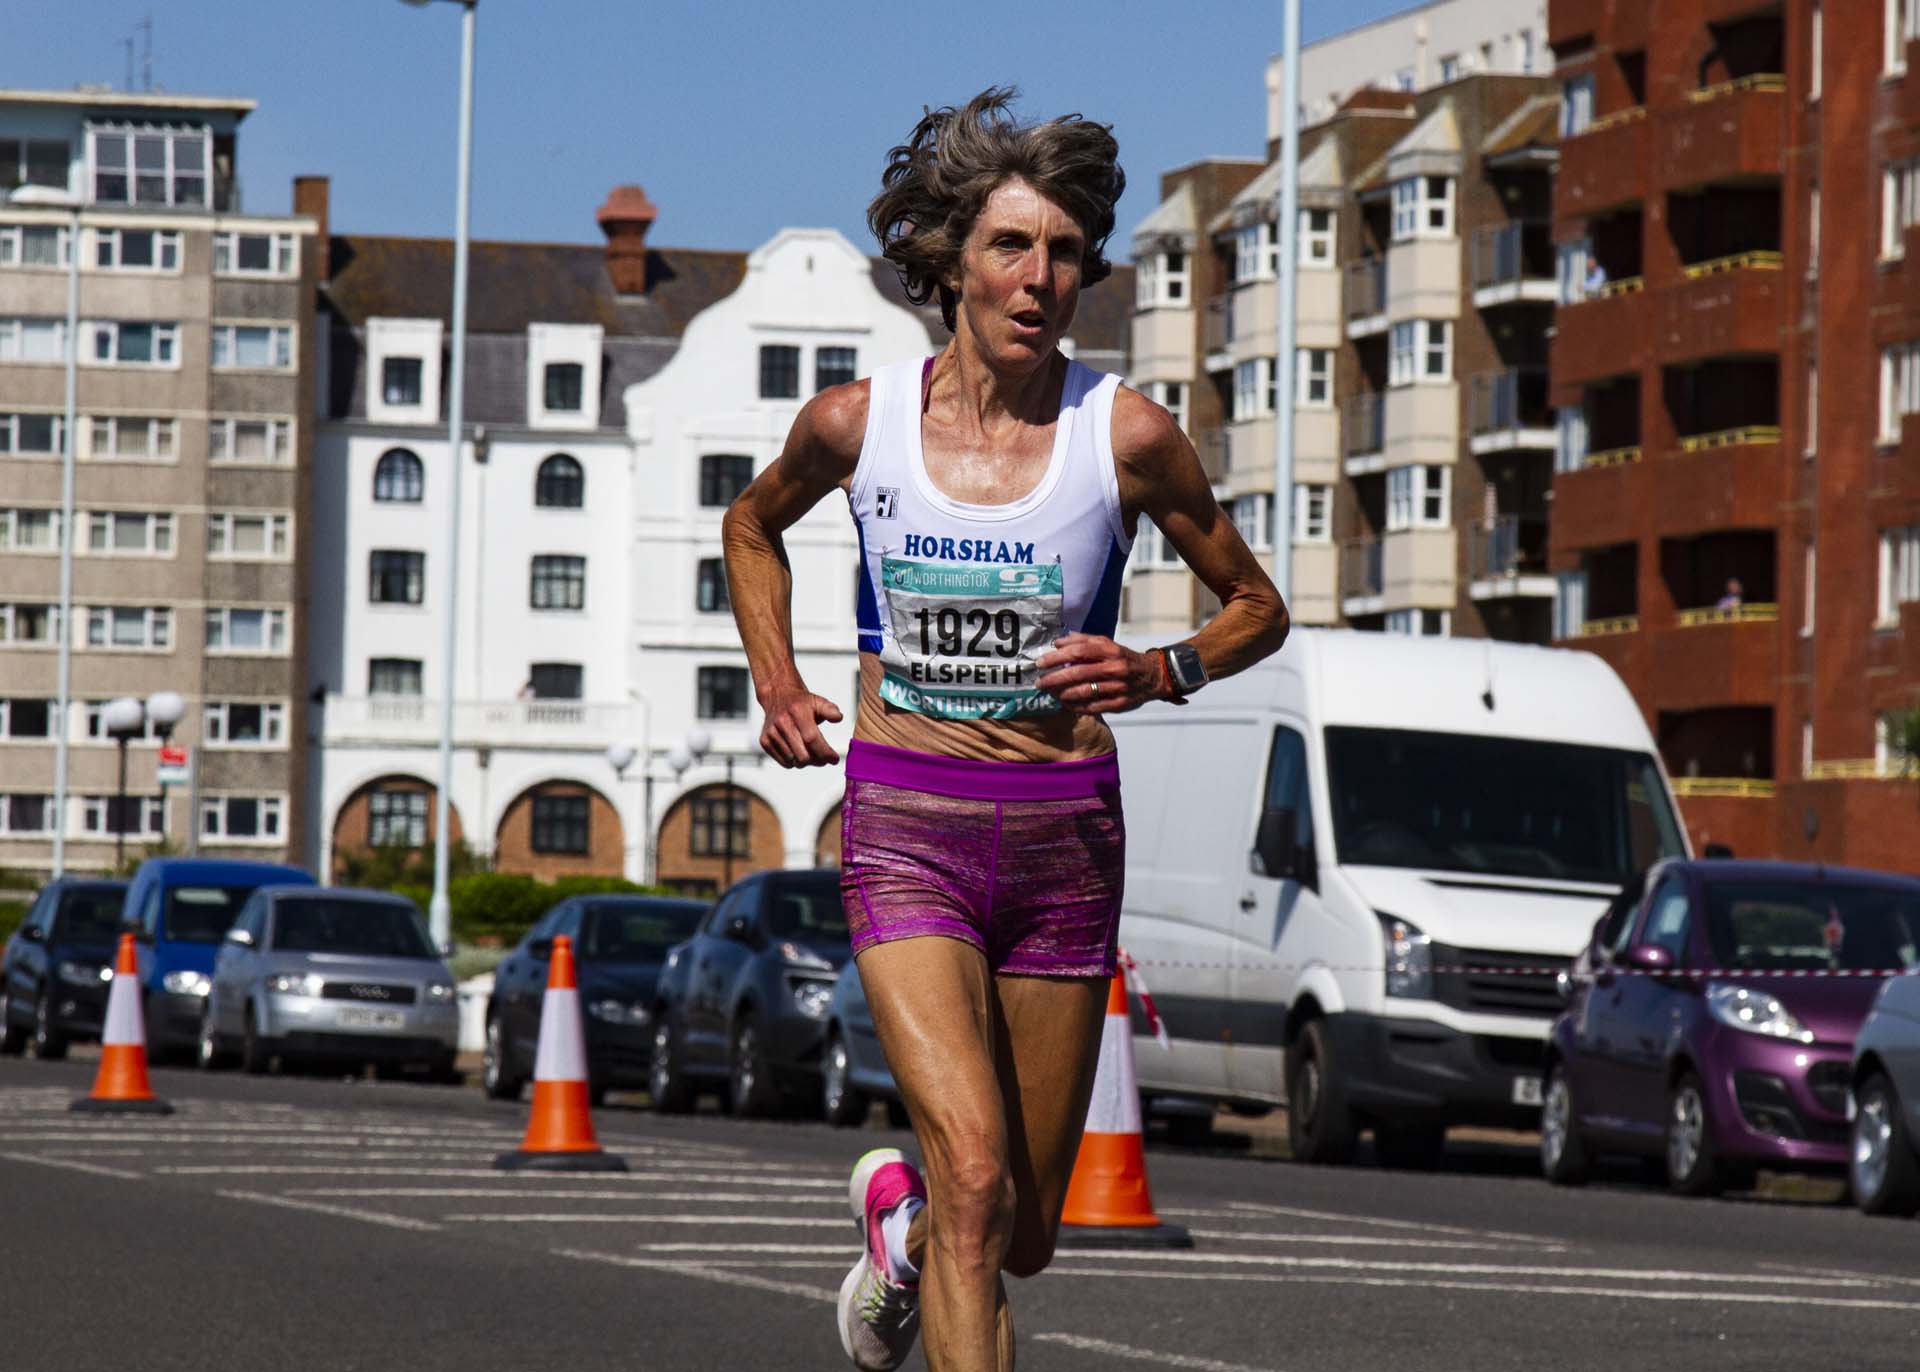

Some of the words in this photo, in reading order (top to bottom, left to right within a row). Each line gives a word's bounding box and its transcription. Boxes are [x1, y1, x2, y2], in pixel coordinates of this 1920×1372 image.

[904, 534, 1034, 564] HORSHAM
[915, 608, 1021, 657] 1929
[911, 662, 1021, 684] ELSPETH
[888, 681, 1006, 713] WORTHING
